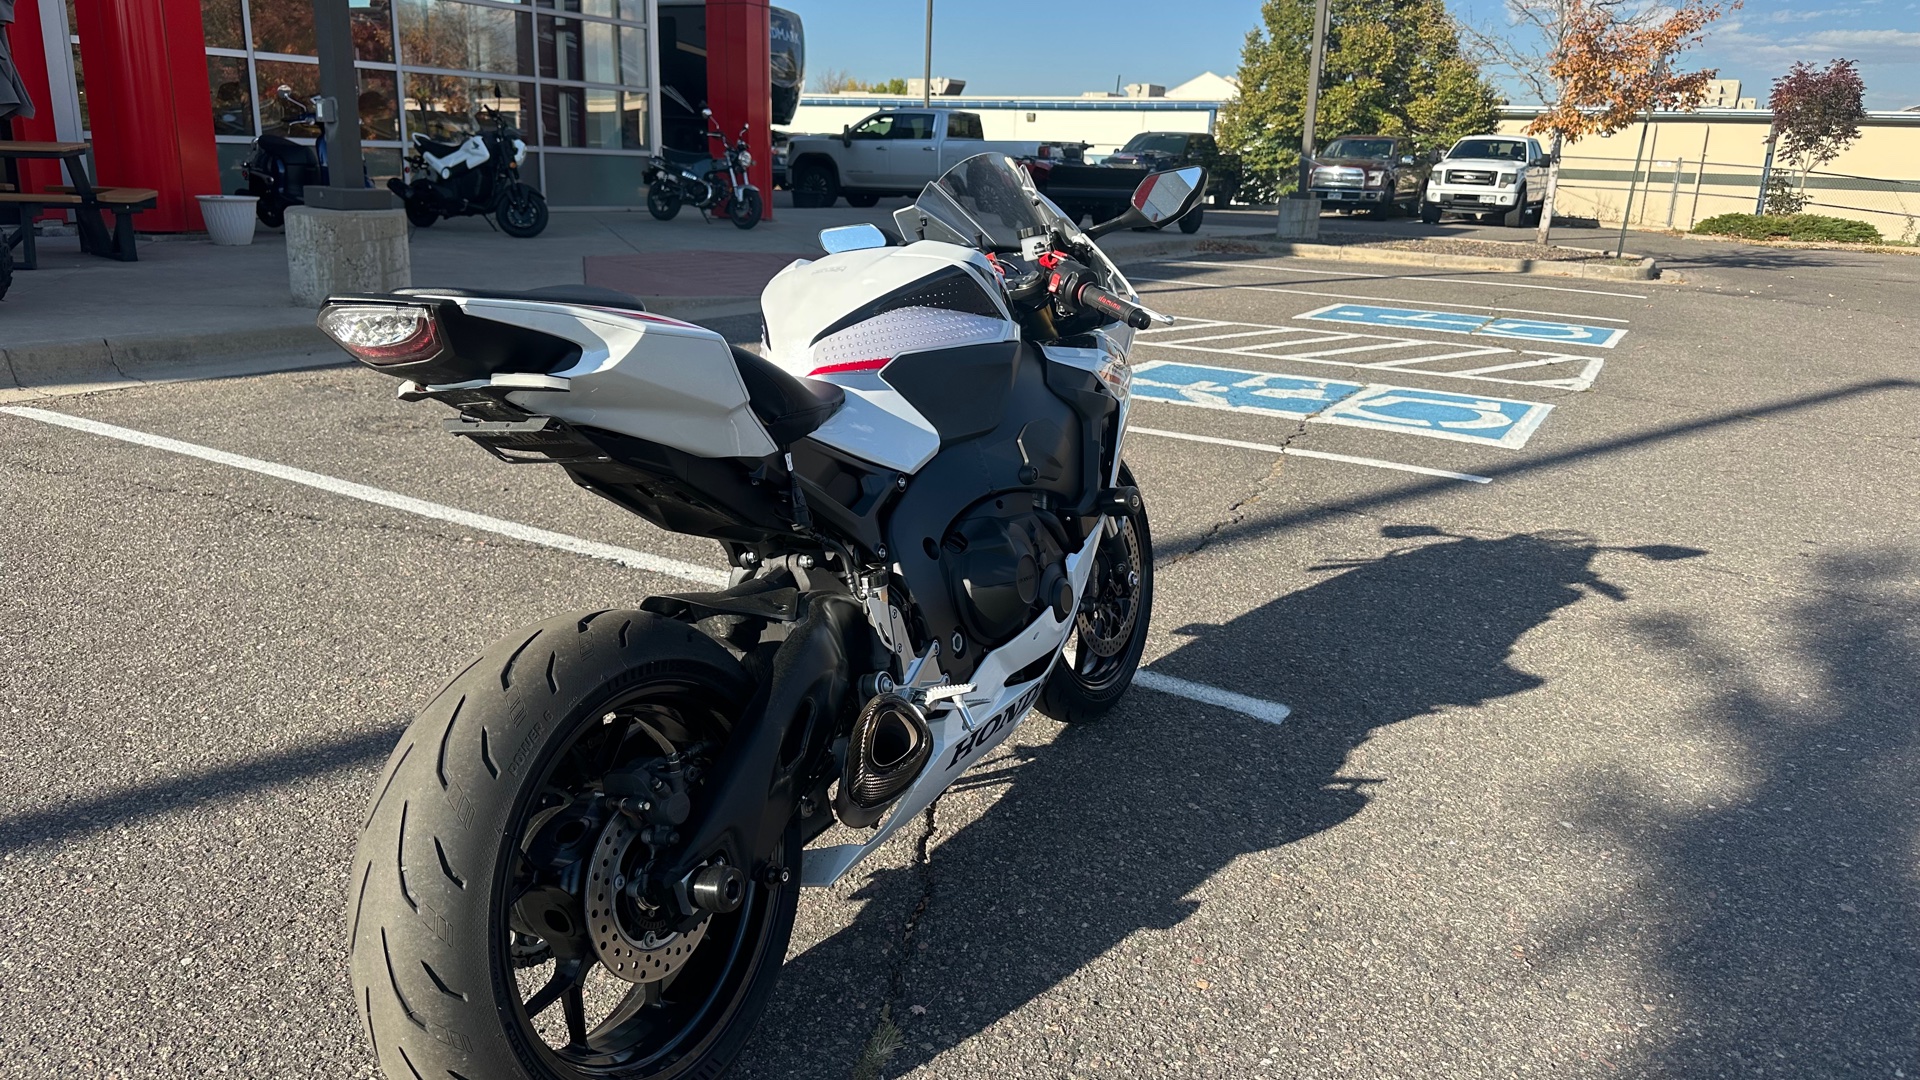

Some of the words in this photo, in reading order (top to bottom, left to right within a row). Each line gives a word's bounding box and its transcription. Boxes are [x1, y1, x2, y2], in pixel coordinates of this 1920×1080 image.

[770, 26, 801, 45] DMARK
[507, 720, 546, 777] POWER
[542, 709, 554, 722] 6
[508, 1028, 545, 1080] ICHELIN
